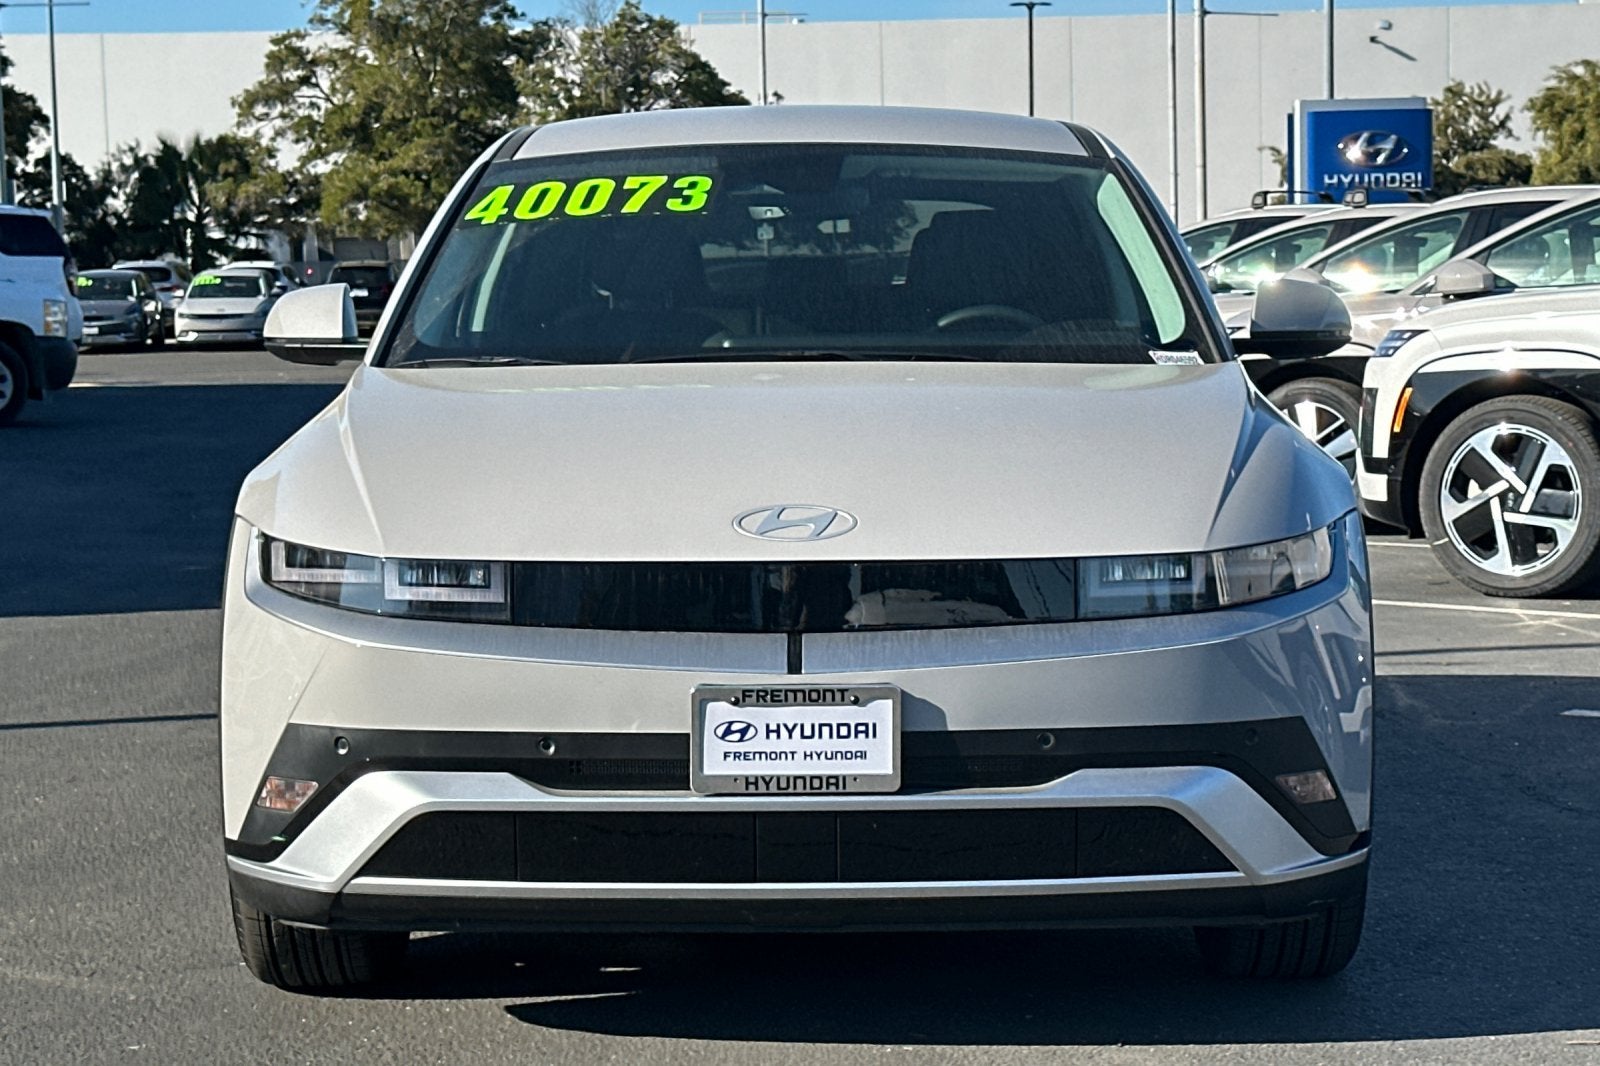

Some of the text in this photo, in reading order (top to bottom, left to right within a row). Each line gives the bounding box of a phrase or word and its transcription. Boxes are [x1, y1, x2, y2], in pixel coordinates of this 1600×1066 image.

[1323, 172, 1423, 188] HYUNDAI
[464, 175, 713, 225] 40073
[741, 688, 849, 703] FREMONT
[765, 722, 877, 740] HYUNDAI
[723, 750, 867, 761] FREMONT HYUNDAI
[744, 775, 847, 791] HYUNDAI
